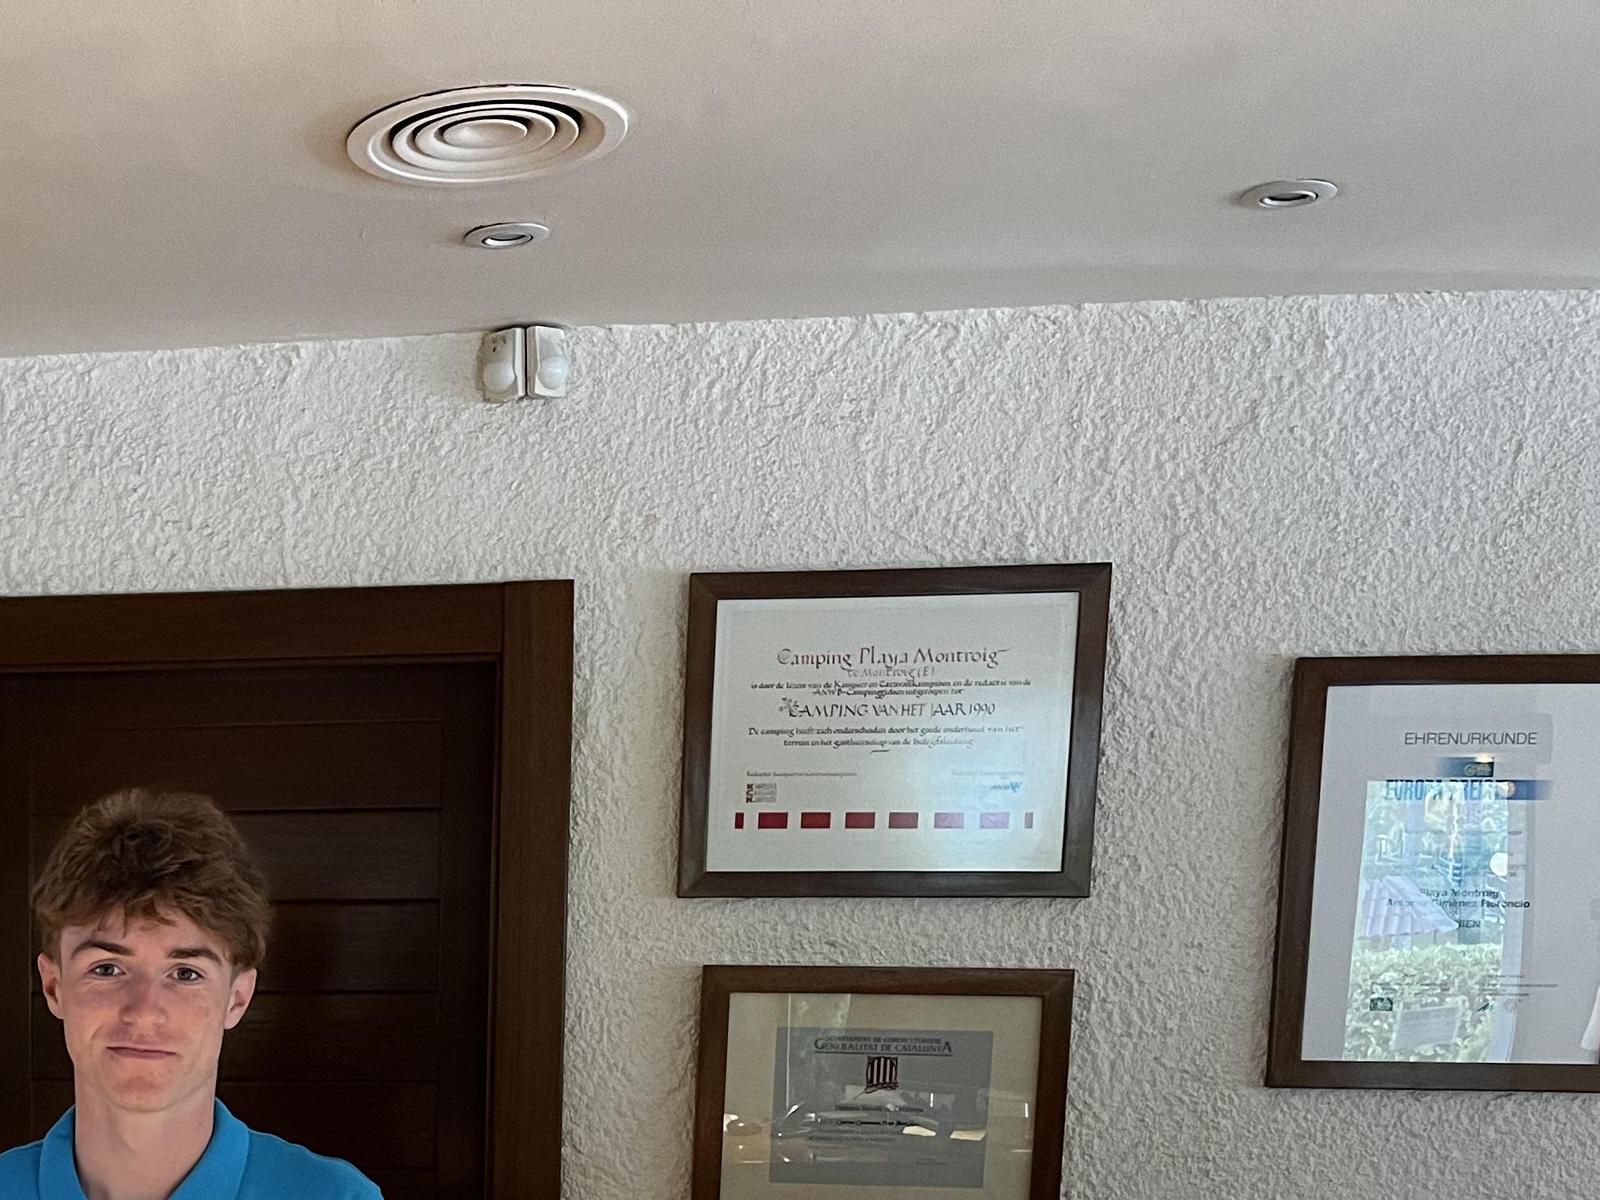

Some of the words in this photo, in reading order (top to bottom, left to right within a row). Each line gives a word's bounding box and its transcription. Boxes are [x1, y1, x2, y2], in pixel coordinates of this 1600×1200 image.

[777, 648, 852, 671] Camping
[859, 645, 908, 669] Playa
[913, 647, 1011, 670] Montroig
[872, 704, 898, 717] VAN
[900, 703, 926, 717] HET
[931, 702, 967, 717] JAAR
[1403, 732, 1538, 745] EHRENURKUNDE
